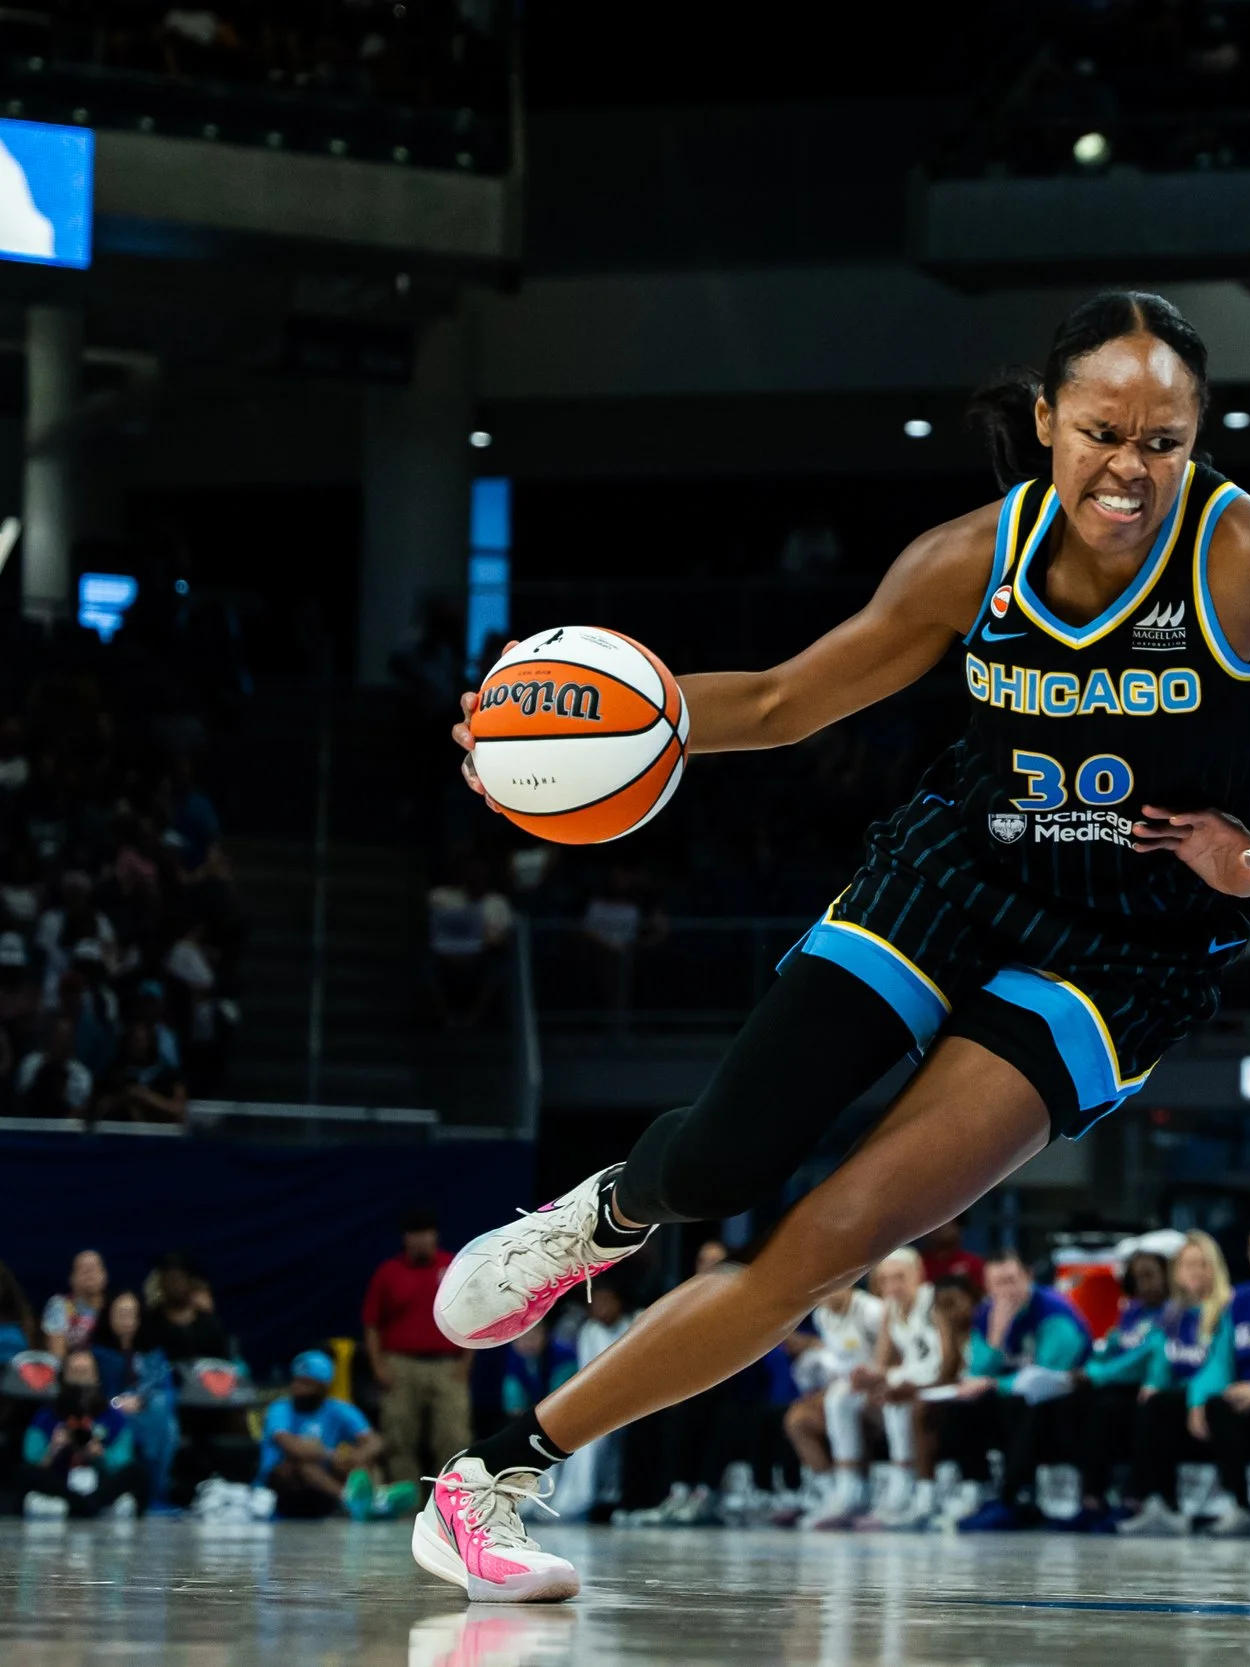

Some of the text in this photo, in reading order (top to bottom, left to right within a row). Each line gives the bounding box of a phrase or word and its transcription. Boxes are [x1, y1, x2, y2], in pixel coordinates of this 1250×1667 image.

[1132, 629, 1187, 641] MAGELLAN
[478, 680, 603, 721] Wilson
[966, 652, 1201, 717] CHICAGO
[1008, 749, 1135, 812] 30
[1034, 810, 1146, 836] UChicag
[1034, 822, 1138, 850] Medicin
